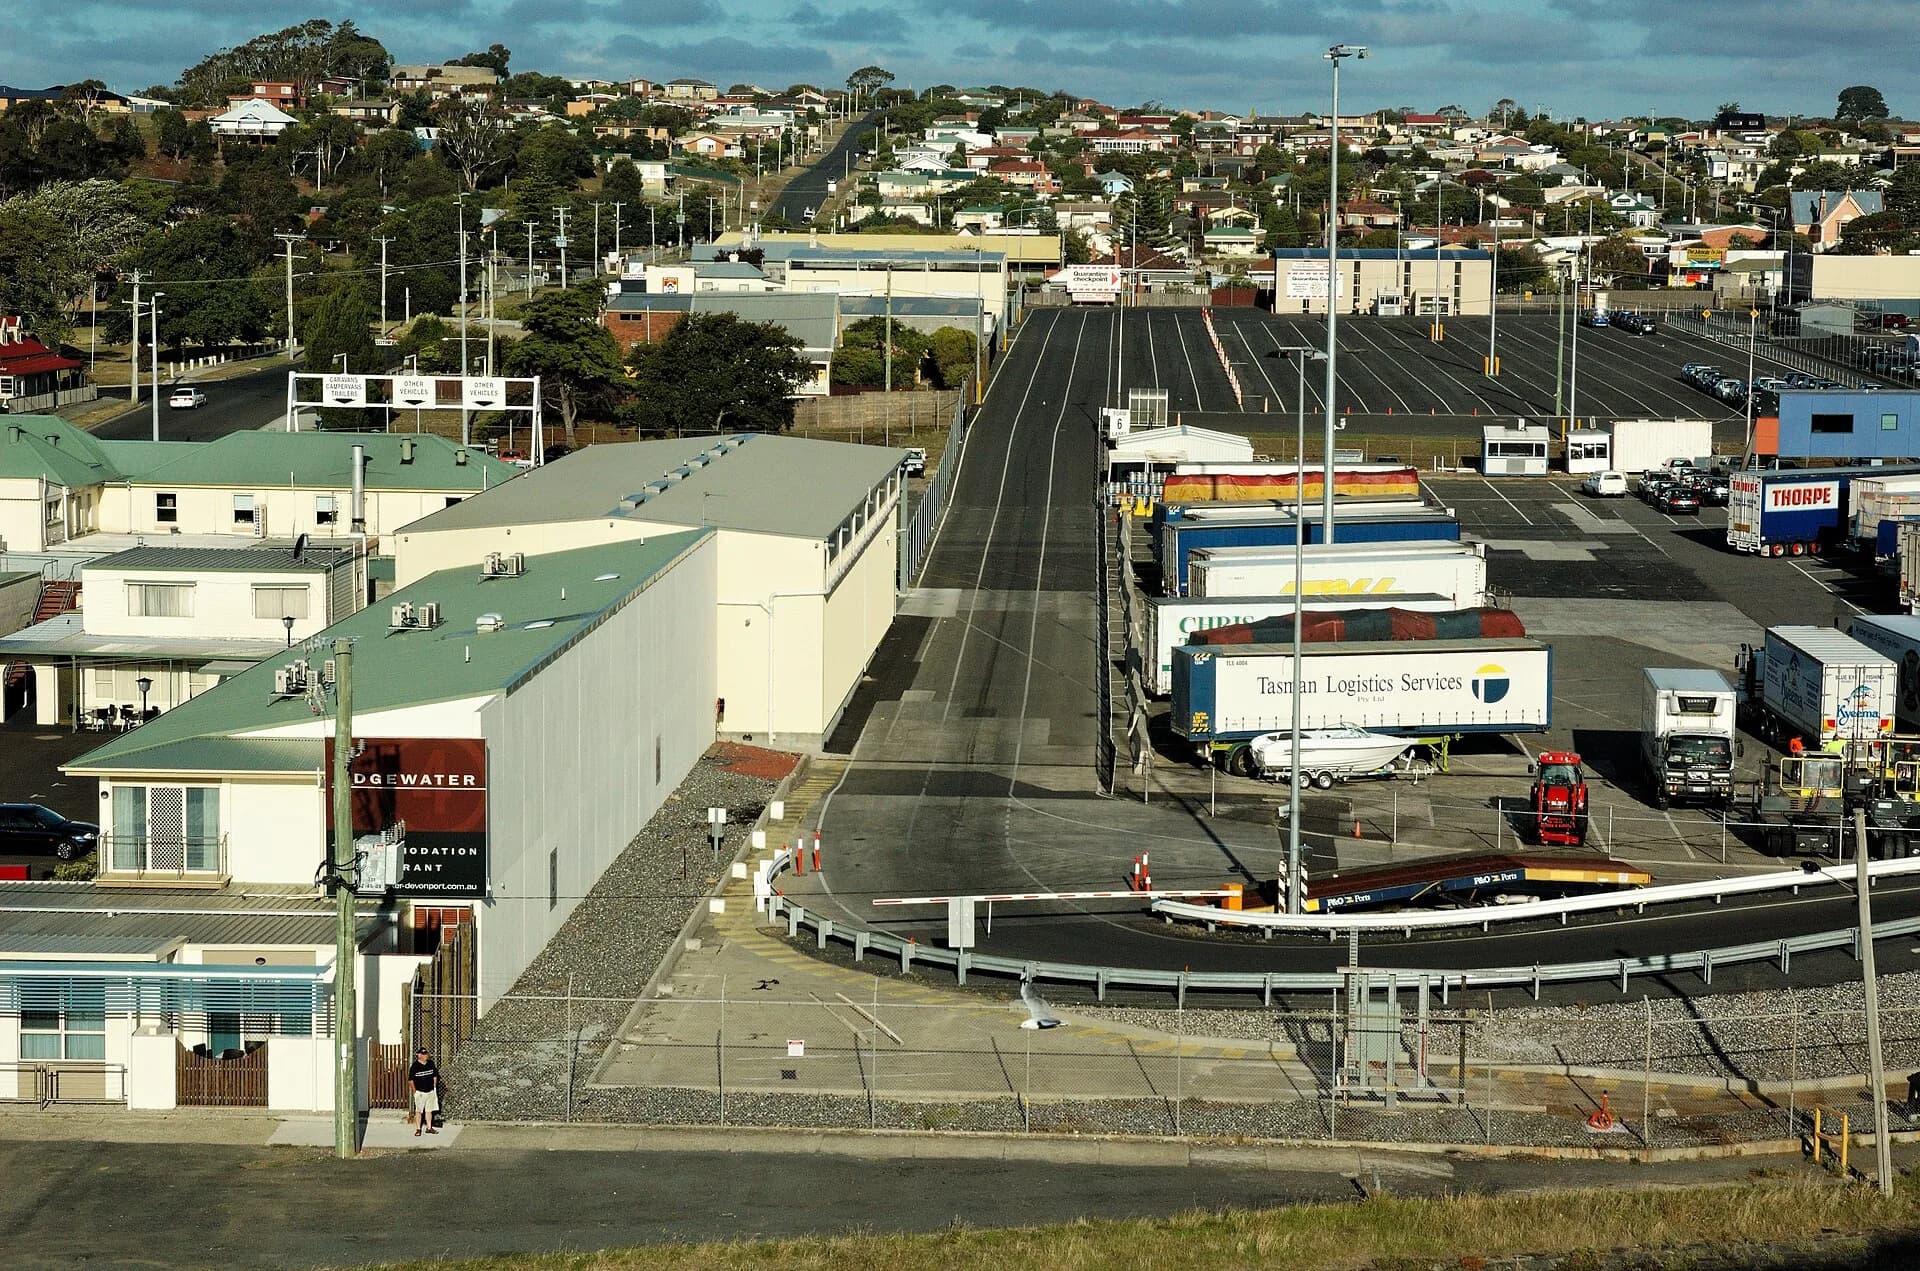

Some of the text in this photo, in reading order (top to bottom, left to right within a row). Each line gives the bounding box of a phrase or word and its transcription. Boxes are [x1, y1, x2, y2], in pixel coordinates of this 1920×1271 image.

[1117, 418, 1122, 429] 6
[1772, 487, 1831, 507] THORPE
[1326, 674, 1394, 697] Logistics
[1401, 672, 1463, 692] Services
[1836, 704, 1879, 726] Kyeema
[352, 773, 477, 786] DGEWATER
[403, 847, 477, 856] ODATION
[1473, 873, 1517, 885] P&O Ports
[391, 882, 478, 891] er-devonport.com.au
[1327, 894, 1371, 907] P&O Ports
